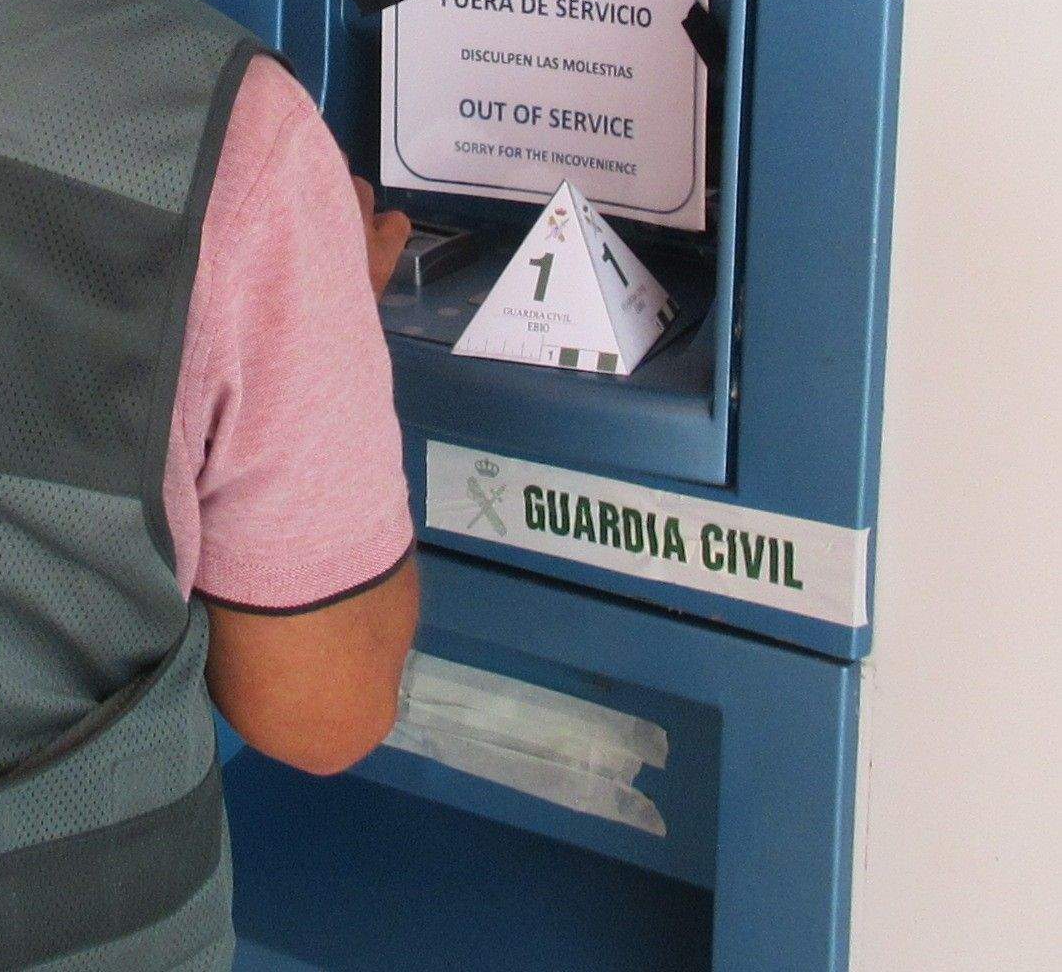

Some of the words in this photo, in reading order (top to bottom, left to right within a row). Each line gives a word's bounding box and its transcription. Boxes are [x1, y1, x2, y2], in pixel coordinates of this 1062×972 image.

[461, 48, 532, 66] DISCULPEN
[537, 56, 559, 69] LAS
[563, 59, 634, 79] MOLESTIAS
[459, 98, 506, 122] OUT
[514, 104, 542, 126] OF
[549, 108, 634, 139] SERVICE
[455, 140, 495, 156] SORRY
[498, 145, 522, 159] FOR
[526, 148, 548, 162] THE
[551, 152, 637, 176] INCOVENIENCE
[529, 252, 555, 302] 1
[603, 242, 629, 288] 1
[503, 308, 545, 320] GUARDIA
[546, 312, 572, 322] CIVIL
[523, 485, 688, 563] GUARDIA
[701, 523, 804, 590] CIVIL
